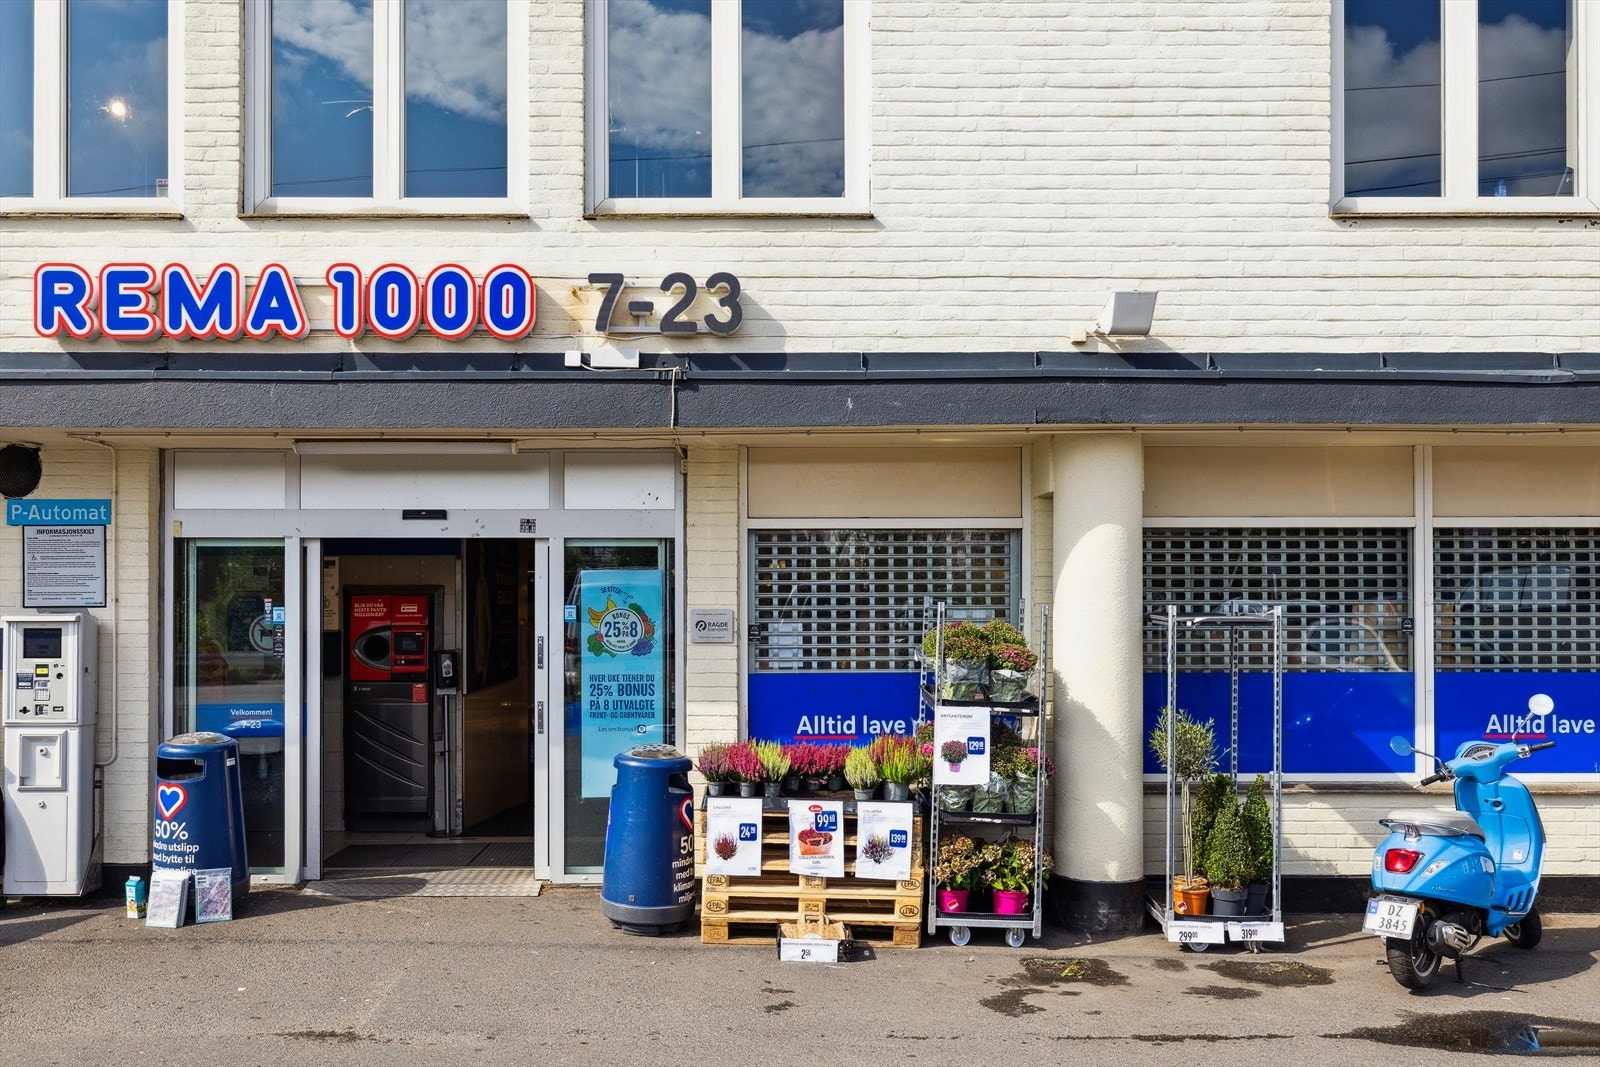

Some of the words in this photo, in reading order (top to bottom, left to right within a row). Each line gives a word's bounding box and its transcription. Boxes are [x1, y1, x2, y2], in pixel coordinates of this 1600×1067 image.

[34, 263, 304, 339] REMA
[326, 263, 537, 339] 1000
[587, 271, 743, 336] 7-23
[11, 504, 107, 521] P-Automat
[611, 612, 631, 620] BONUS
[604, 621, 621, 638] 25
[630, 621, 638, 638] 8
[589, 674, 606, 682] HVER
[608, 674, 620, 682] UKE
[622, 674, 644, 682] TJENER
[646, 674, 654, 682] DU
[590, 684, 614, 696] 25%
[618, 684, 655, 696] BONUS
[590, 697, 600, 710] PÅ
[604, 700, 610, 710] 8
[612, 700, 654, 710] UTVALGTE
[242, 720, 262, 728] 7-23
[796, 715, 856, 734] Alltid
[863, 715, 906, 734] lave
[1486, 714, 1545, 734] Alltid
[1552, 714, 1595, 734] lave
[156, 819, 188, 840] 50%
[168, 843, 200, 854] utslipp
[162, 854, 183, 864] bytte
[184, 854, 194, 864] til
[676, 868, 690, 880] med
[710, 876, 722, 884] EPAL
[1388, 904, 1403, 916] DZ
[1379, 917, 1408, 930] 3845
